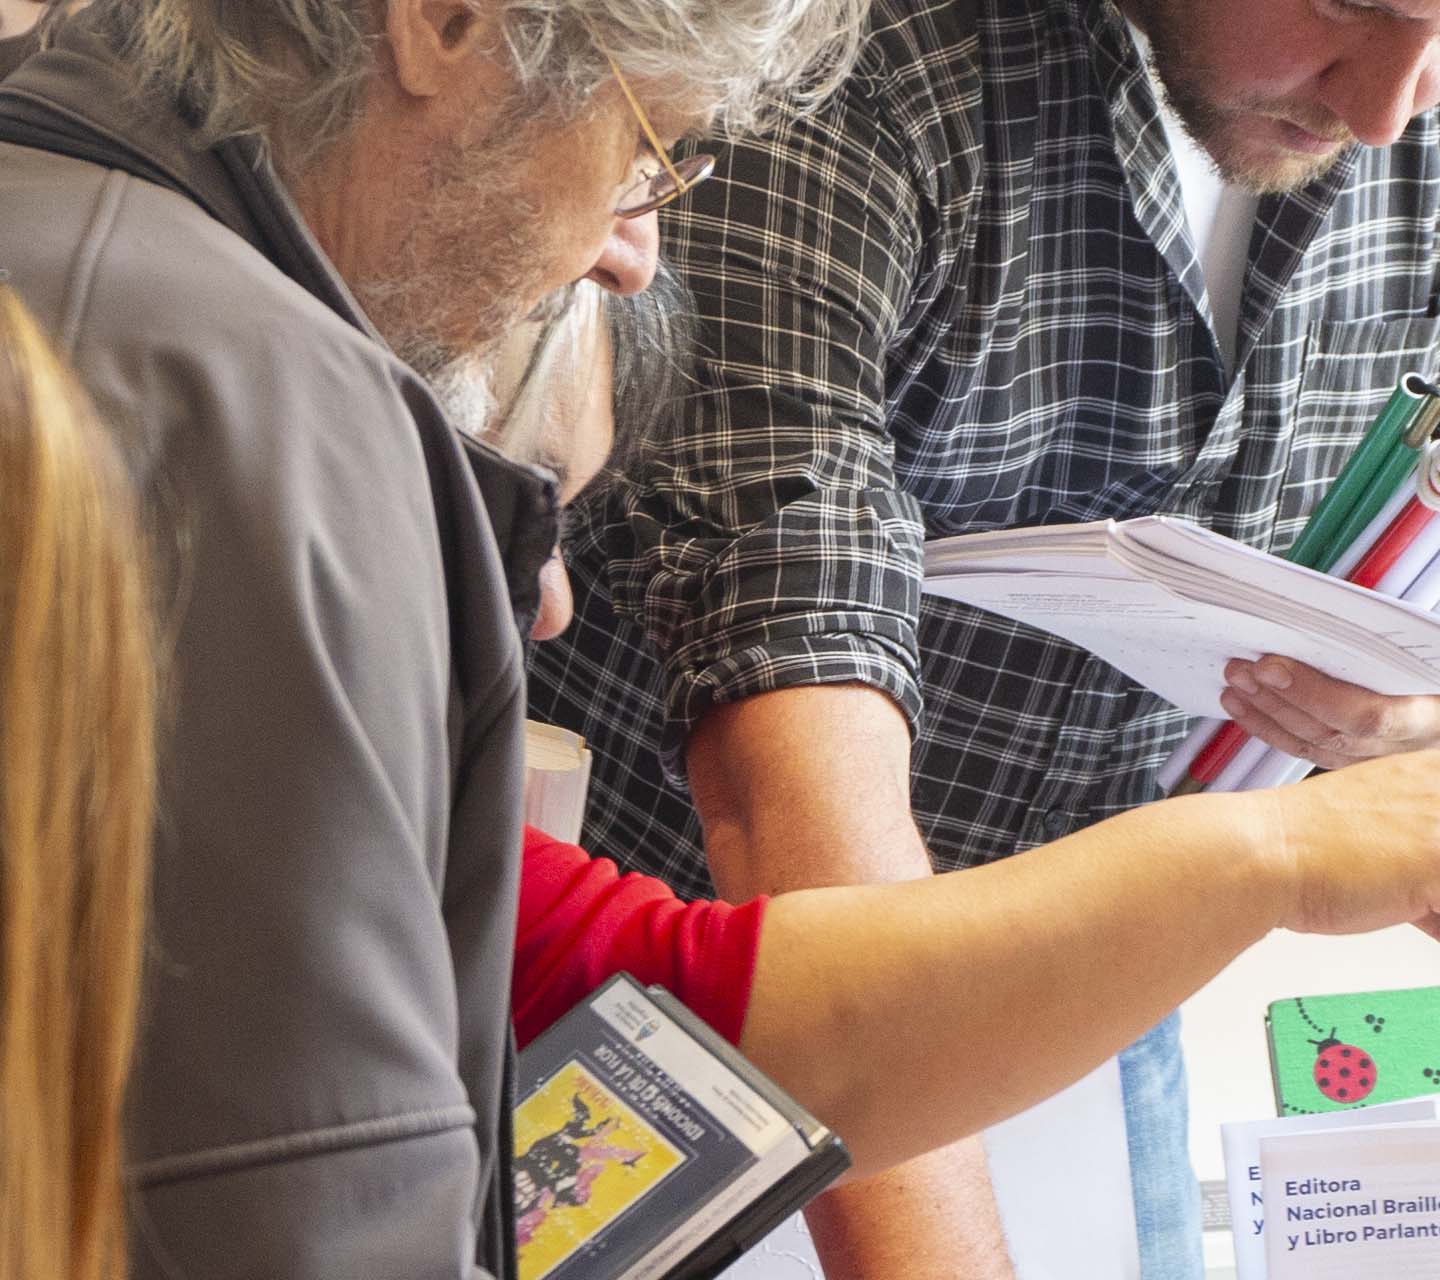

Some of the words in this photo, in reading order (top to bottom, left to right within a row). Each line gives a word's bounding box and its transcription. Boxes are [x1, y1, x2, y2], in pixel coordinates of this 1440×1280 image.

[1285, 1178, 1361, 1196] Editora
[1286, 1199, 1377, 1222] Nacional
[1288, 1233, 1300, 1251] y
[1305, 1228, 1357, 1246] Libro
